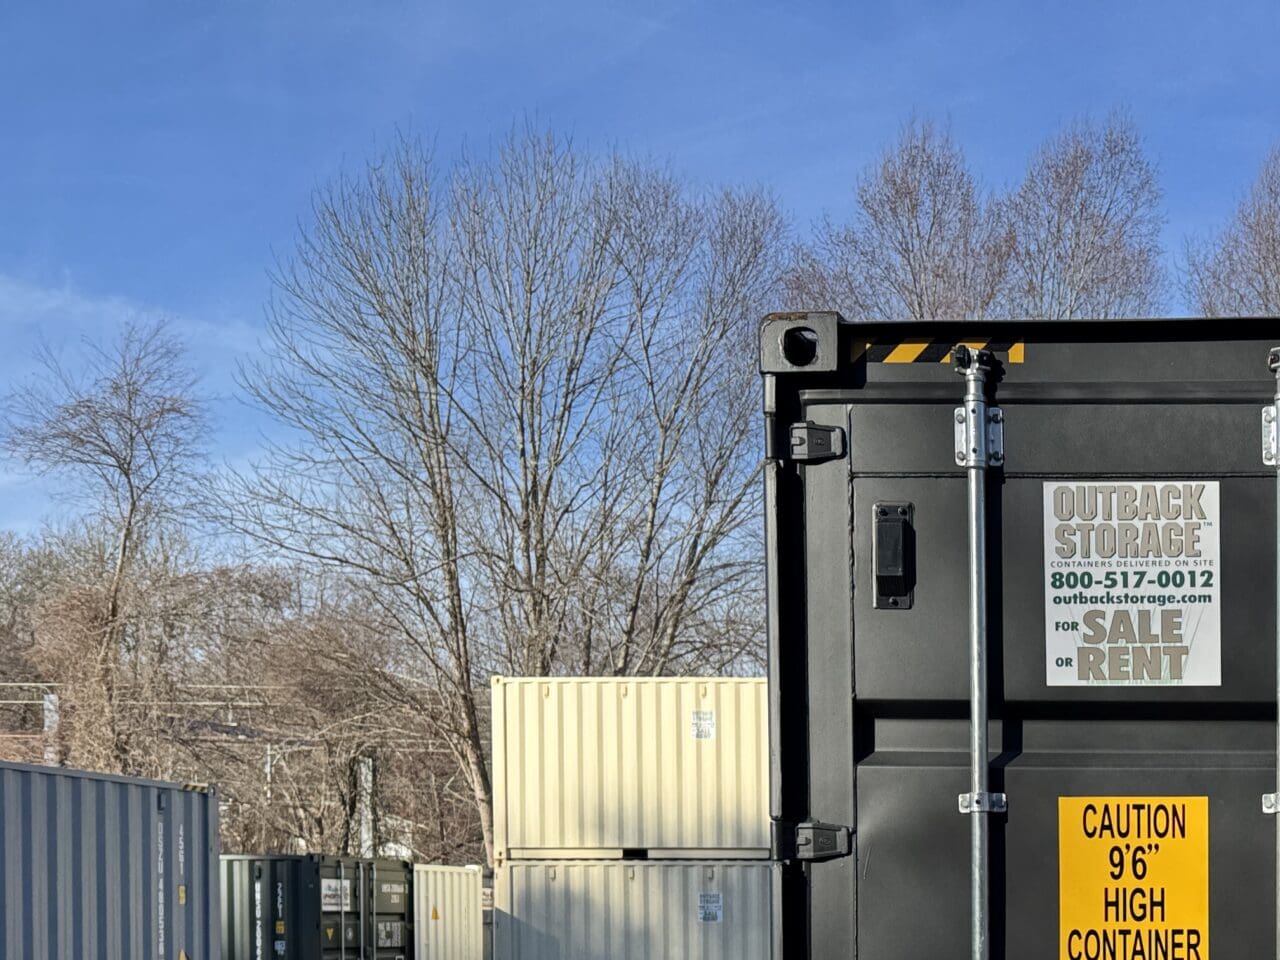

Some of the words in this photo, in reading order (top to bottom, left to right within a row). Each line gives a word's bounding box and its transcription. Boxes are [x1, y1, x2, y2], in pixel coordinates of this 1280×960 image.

[1053, 484, 1207, 521] OUTBACK
[1054, 522, 1202, 559] STORAGE
[1050, 560, 1113, 568] CONTAINERS
[1116, 560, 1171, 568] DELIVERED
[1175, 559, 1189, 567] ON
[1193, 559, 1214, 567] SITE
[1050, 570, 1214, 589] 800-517-0012
[1052, 591, 1212, 606] outbackstorage.com
[1055, 621, 1079, 632] FOR
[1082, 609, 1184, 644] SALE
[1055, 657, 1073, 668] OR
[1077, 646, 1189, 681] RENT
[1083, 804, 1186, 838] CAUTION
[1104, 888, 1165, 922] HIGH
